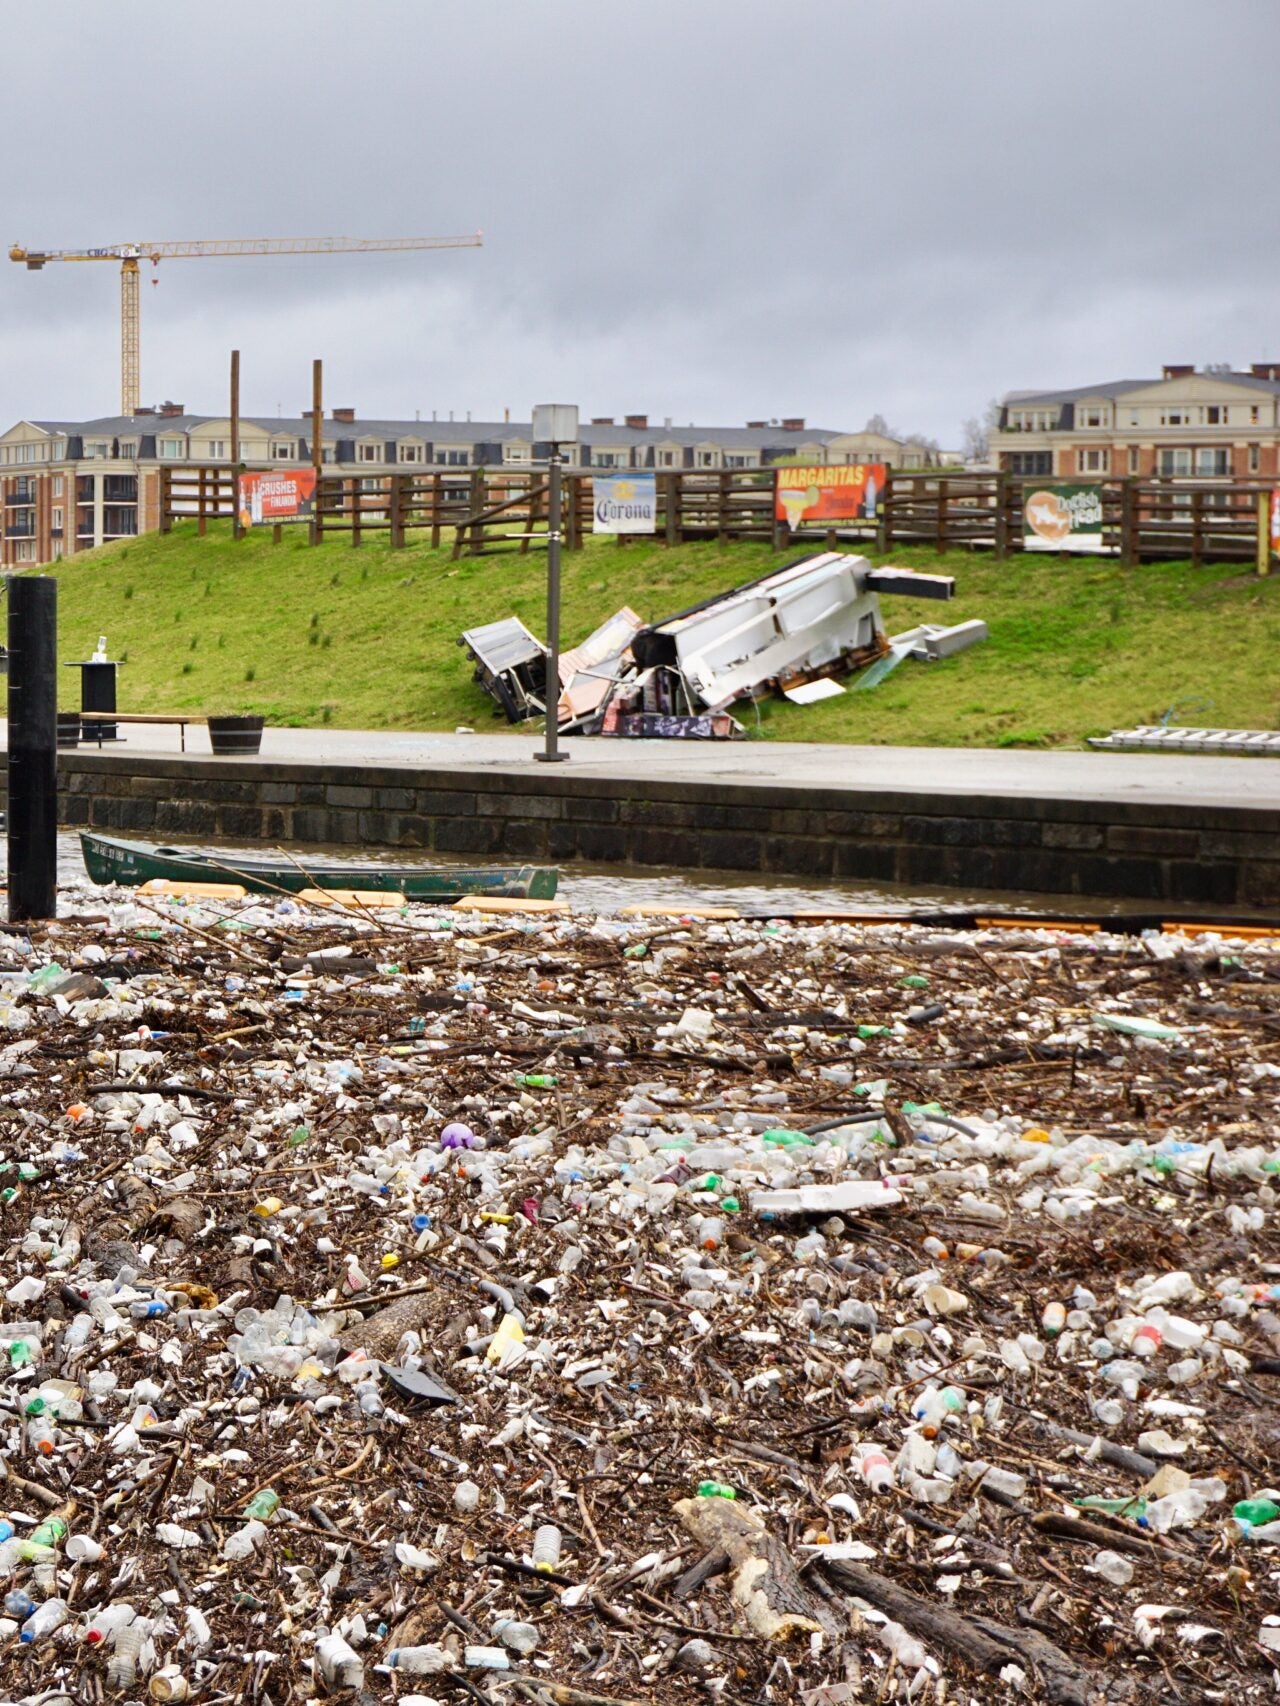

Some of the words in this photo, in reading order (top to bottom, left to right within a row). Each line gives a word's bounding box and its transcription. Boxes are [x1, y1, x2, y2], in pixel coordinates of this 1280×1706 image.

[260, 479, 297, 497] CRUSHES
[777, 465, 864, 488] MARGARITAS
[597, 499, 652, 525] Corona
[1056, 491, 1099, 513] Dogfish
[1067, 502, 1103, 529] Head
